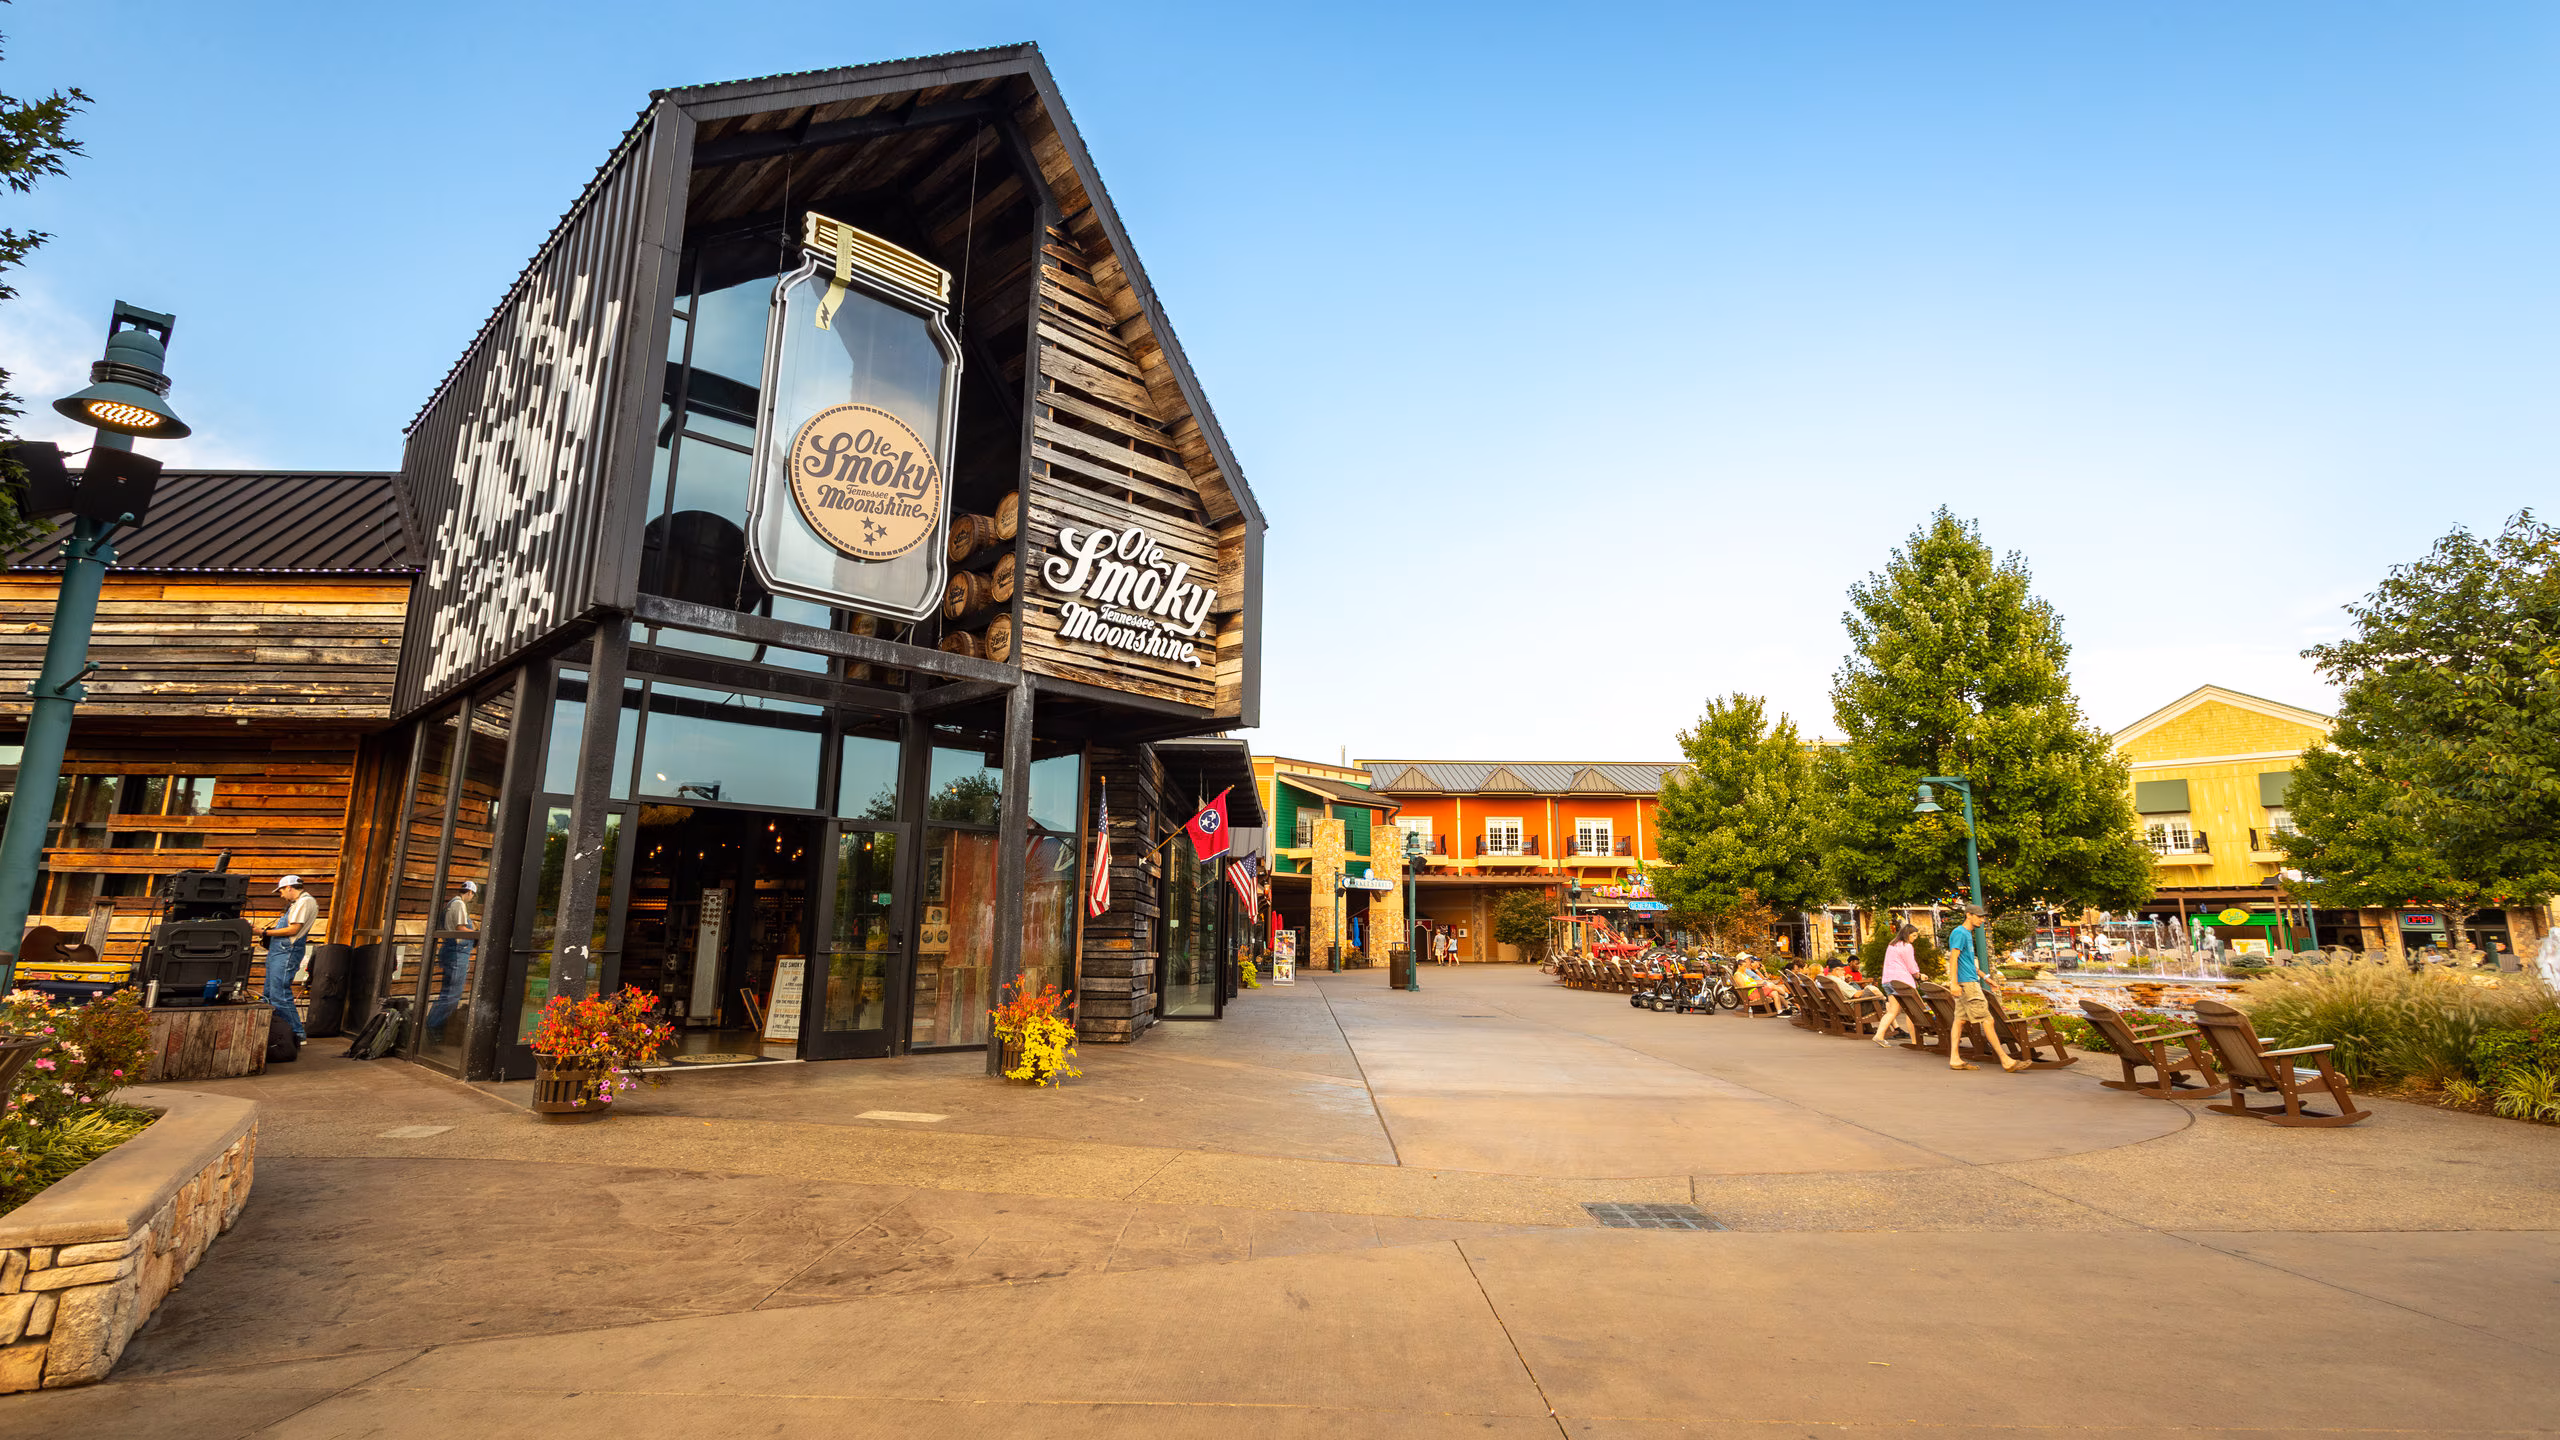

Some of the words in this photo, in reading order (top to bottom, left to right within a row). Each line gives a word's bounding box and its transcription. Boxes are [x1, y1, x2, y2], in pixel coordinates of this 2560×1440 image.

[855, 429, 899, 461] Ole
[803, 432, 936, 500] Smoky
[817, 484, 929, 521] Moonshine
[846, 484, 889, 499] Tennessee
[1117, 527, 1172, 576] Ole
[1043, 527, 1218, 637] Smoky
[1059, 601, 1201, 668] Moonshine
[1100, 603, 1156, 630] Tennessee
[1630, 901, 1656, 910] GENERAL
